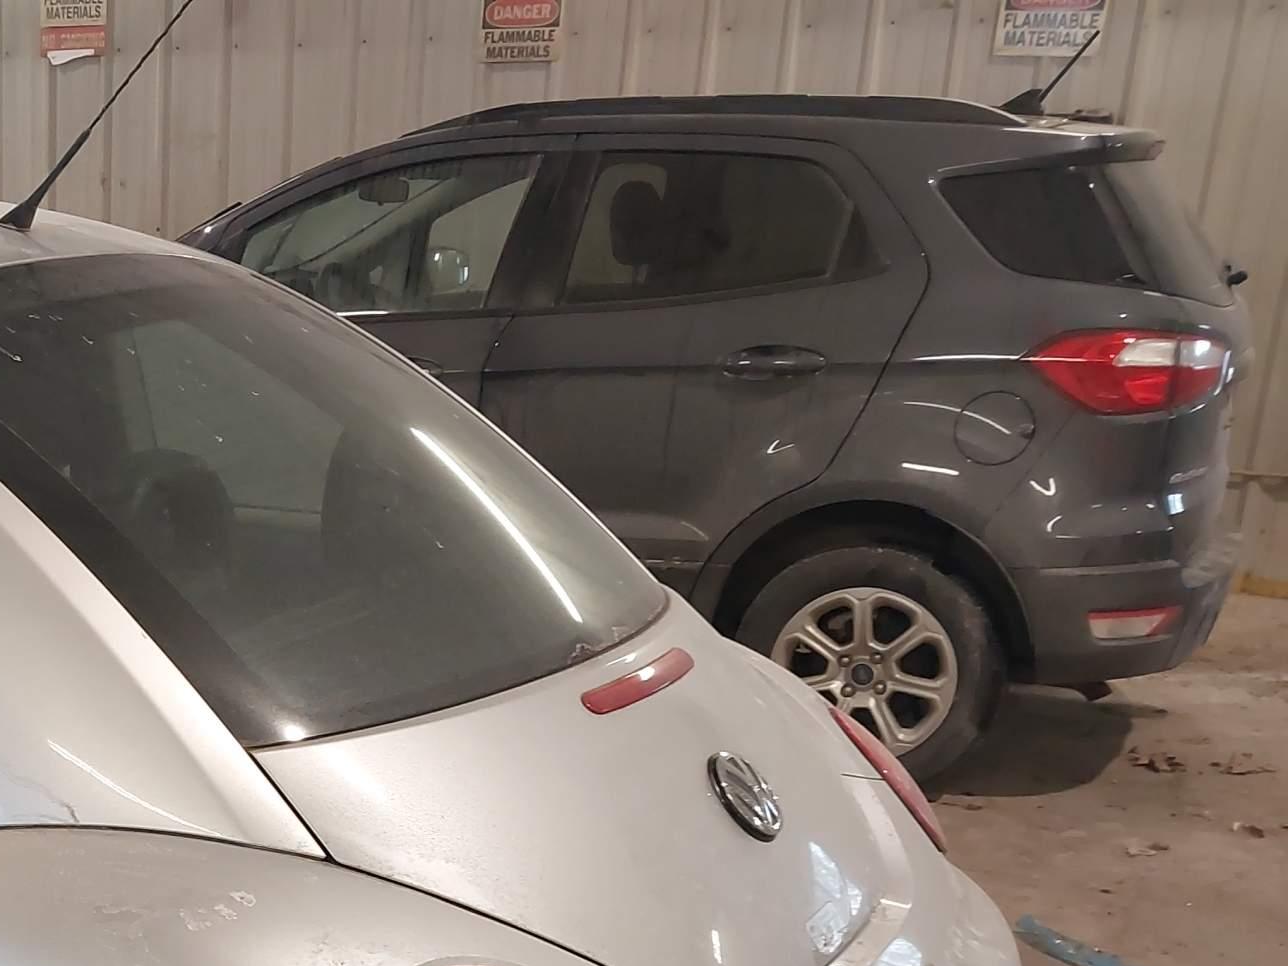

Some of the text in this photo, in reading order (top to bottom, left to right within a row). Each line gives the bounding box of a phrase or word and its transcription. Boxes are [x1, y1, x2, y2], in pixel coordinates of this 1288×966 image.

[46, 5, 102, 19] MATERIALS
[494, 4, 552, 20] DANGER
[1003, 12, 1100, 29] FLAMMABLE
[484, 29, 556, 44] FLAMMABLE
[486, 45, 551, 59] MATERIALS
